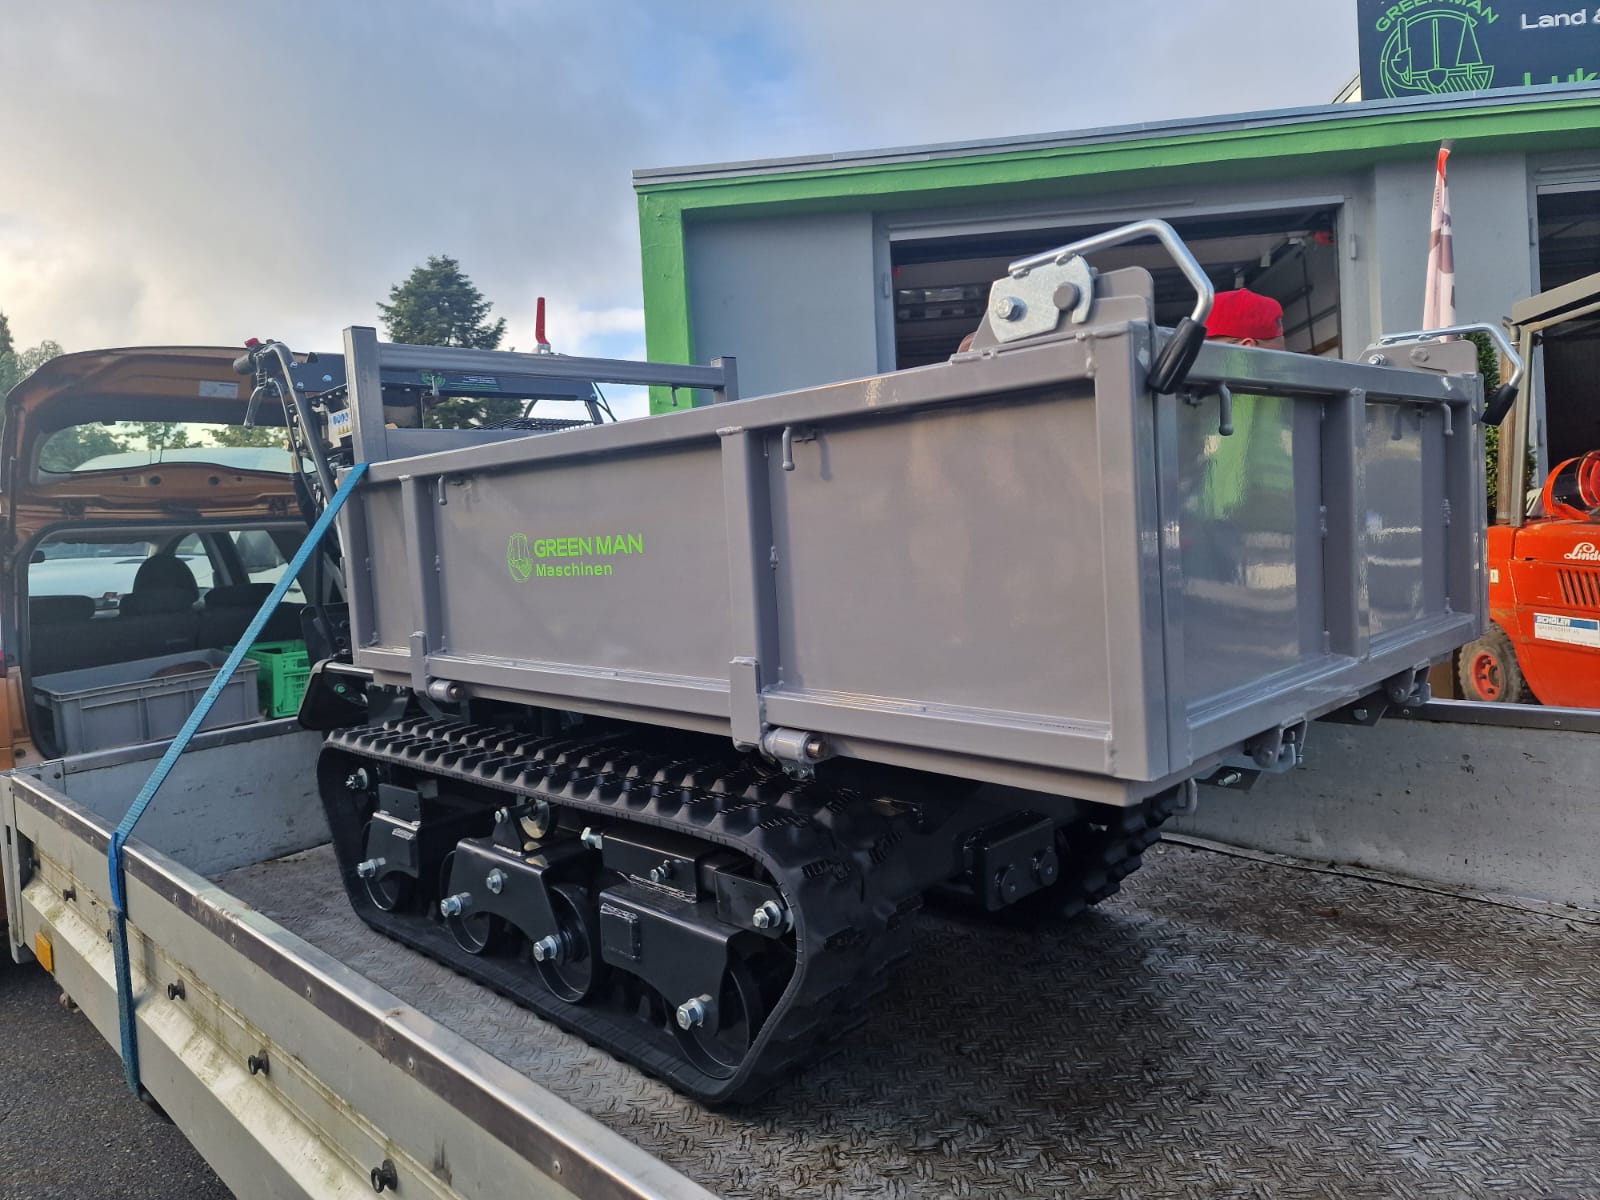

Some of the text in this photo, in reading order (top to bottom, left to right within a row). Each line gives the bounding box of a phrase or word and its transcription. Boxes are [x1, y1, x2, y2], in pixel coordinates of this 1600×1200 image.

[1449, 0, 1499, 24] AN
[1521, 8, 1587, 30] Land
[533, 533, 644, 558] GREEN MAN
[1563, 542, 1600, 562] Lind
[535, 561, 614, 577] Maschinen
